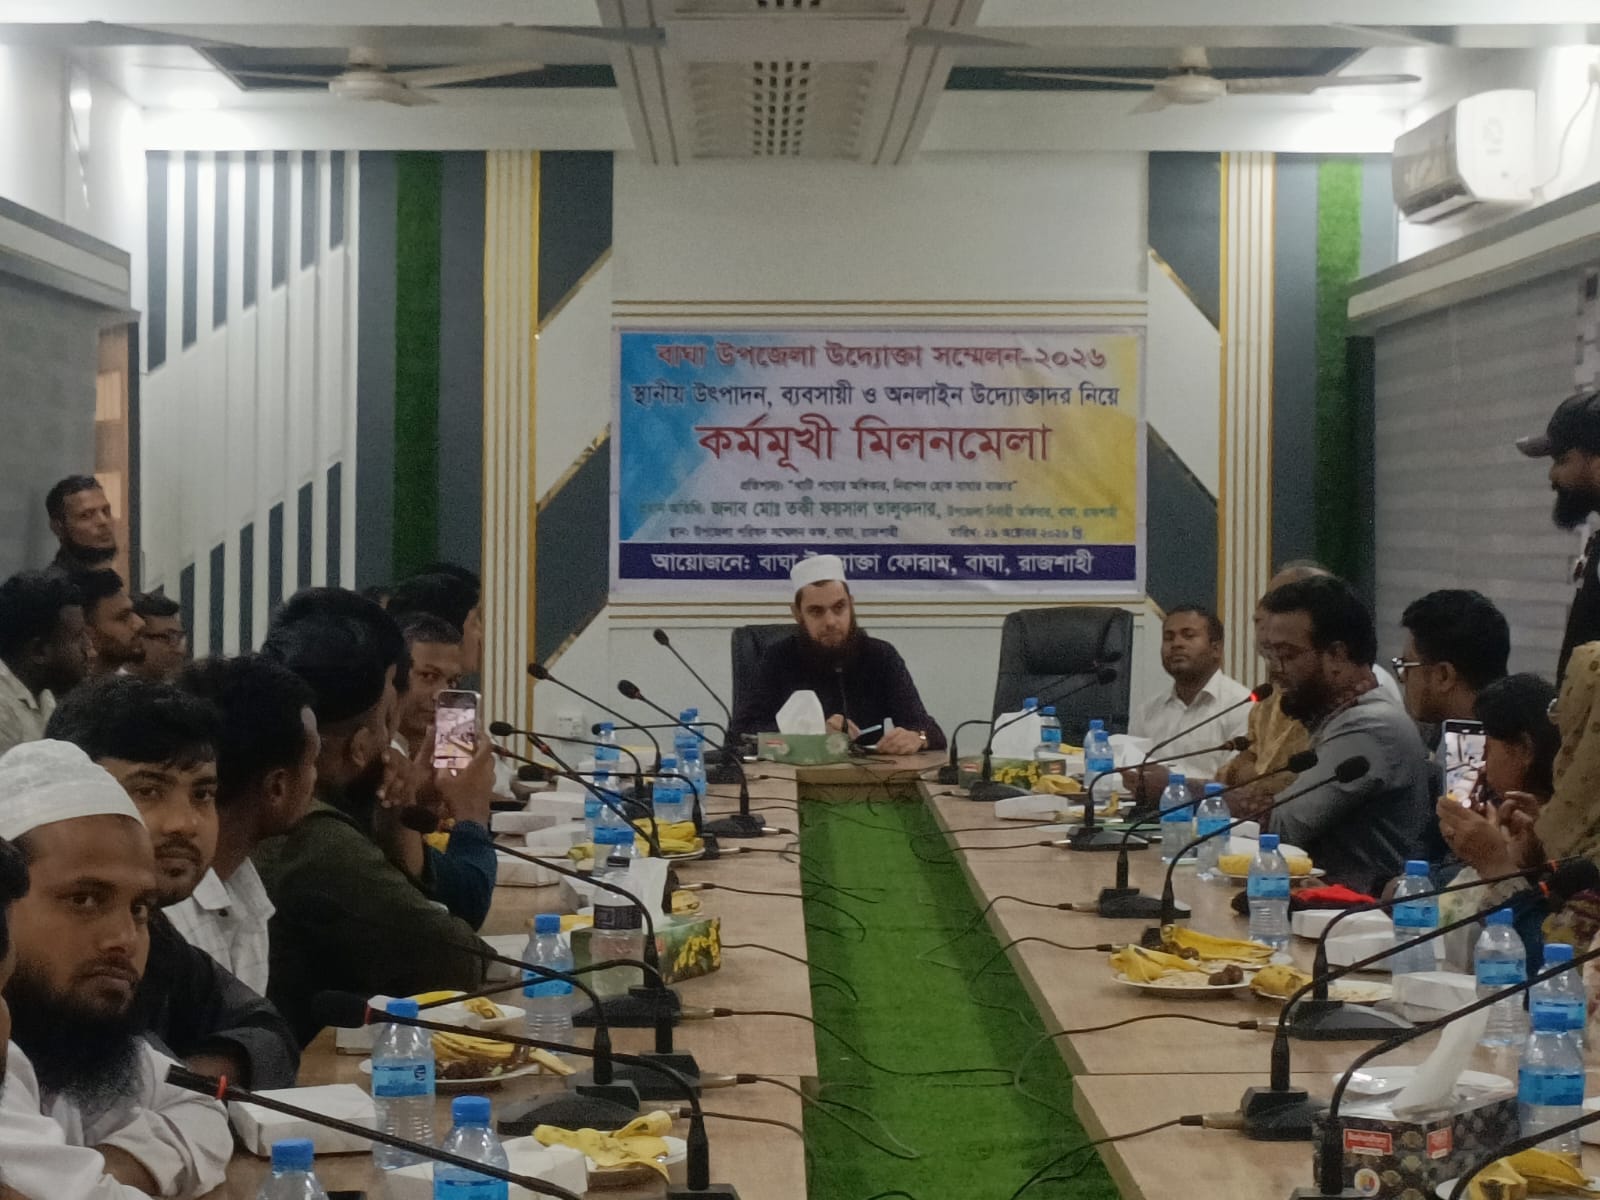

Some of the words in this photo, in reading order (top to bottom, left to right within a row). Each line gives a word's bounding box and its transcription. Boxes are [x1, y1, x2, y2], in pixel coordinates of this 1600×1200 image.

[656, 344, 707, 367] বাঘা
[716, 341, 816, 368] উপজেলা
[825, 341, 924, 369] উদ্যোক্তা
[931, 346, 1108, 370] সম্মেলন-২০২৬
[632, 378, 686, 407] স্থানীয়
[693, 381, 773, 409] উৎপাদন,
[780, 379, 855, 407] ব্যবসায়ী
[861, 388, 877, 405] ও
[884, 382, 964, 408] অনলাইন
[1078, 381, 1121, 407] নিয়ে
[850, 414, 1053, 462] মিলনমেলা
[710, 501, 748, 517] জনাব
[757, 552, 799, 573] বাঘা
[887, 552, 959, 576] ফোরাম,
[964, 552, 1012, 576] বাঘা,
[1018, 548, 1095, 574] রাজশাহী
